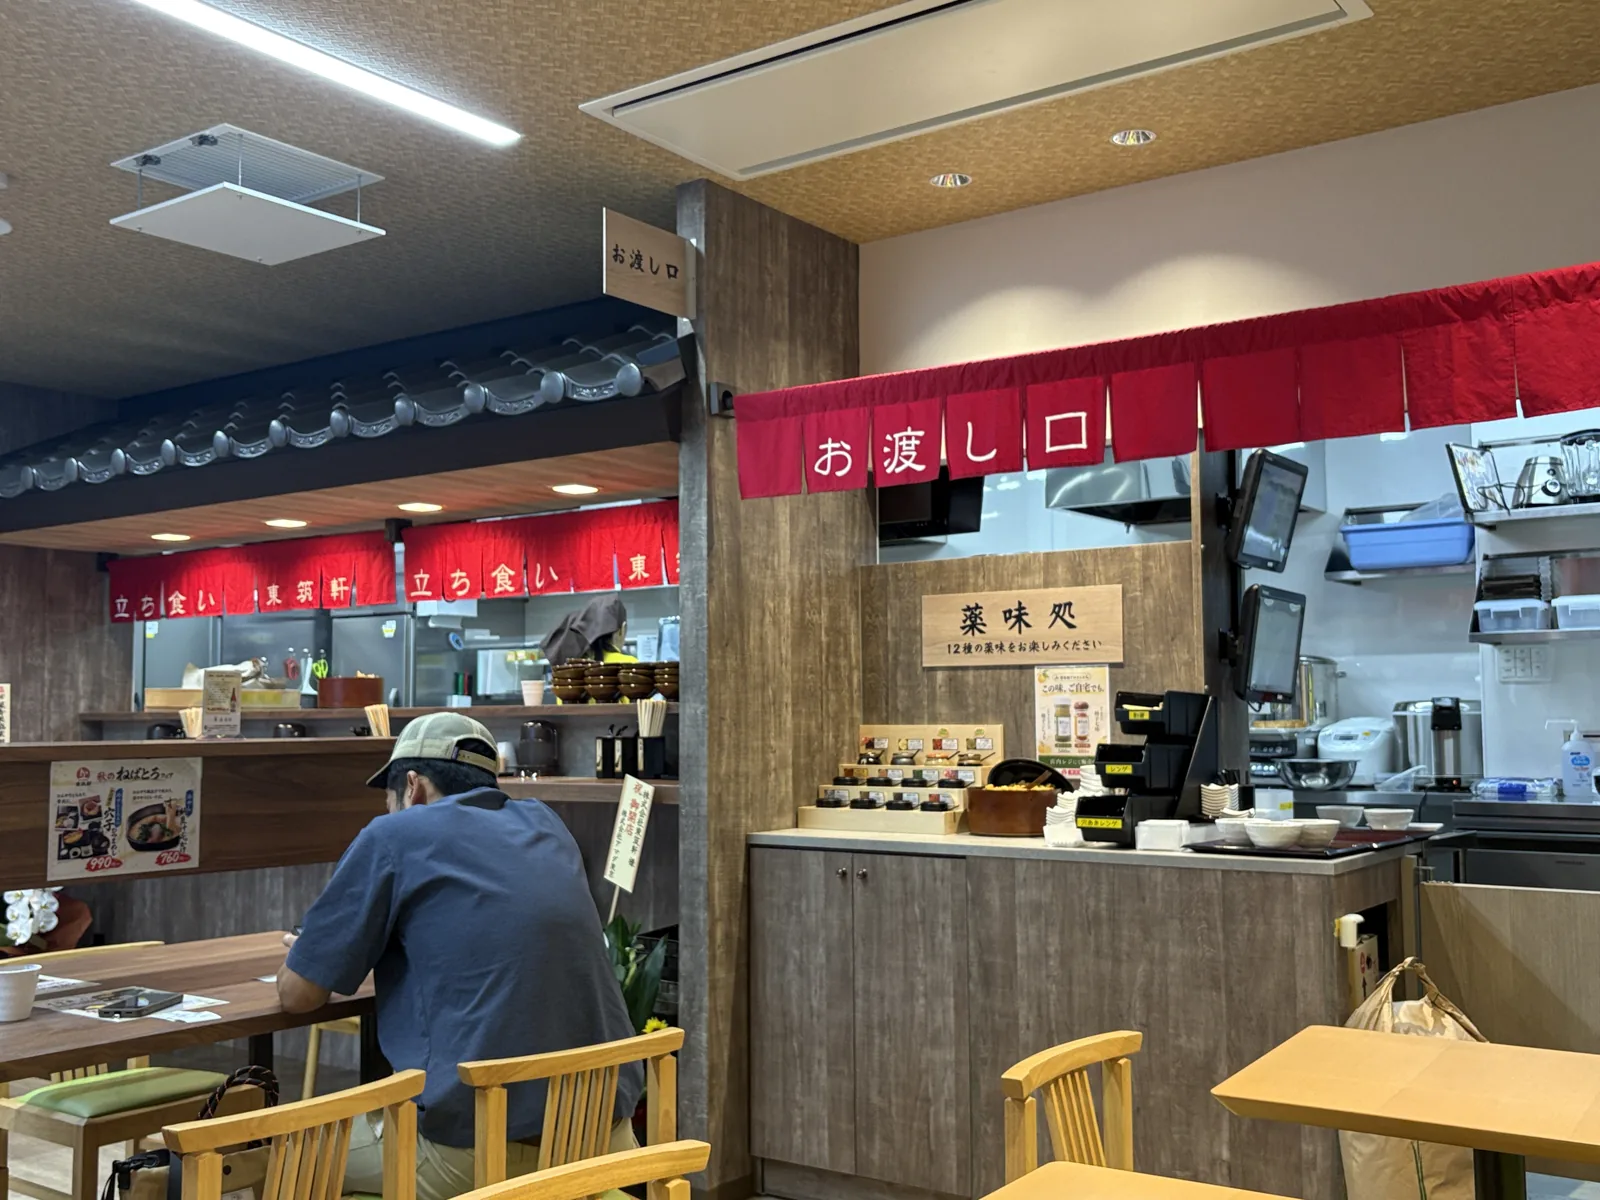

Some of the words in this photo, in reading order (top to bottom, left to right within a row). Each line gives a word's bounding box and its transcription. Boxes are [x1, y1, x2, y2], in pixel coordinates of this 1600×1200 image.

[612, 243, 679, 279] お渡し口
[813, 411, 1088, 478] お渡し口
[266, 576, 350, 606] 東筑軒
[410, 562, 559, 597] 立ち食い
[114, 589, 215, 618] 立ち食い
[959, 600, 1077, 637] 薬味処
[947, 639, 1102, 655] 12種の薬味をお楽しみください
[90, 856, 112, 870] 990
[160, 851, 180, 864] 760
